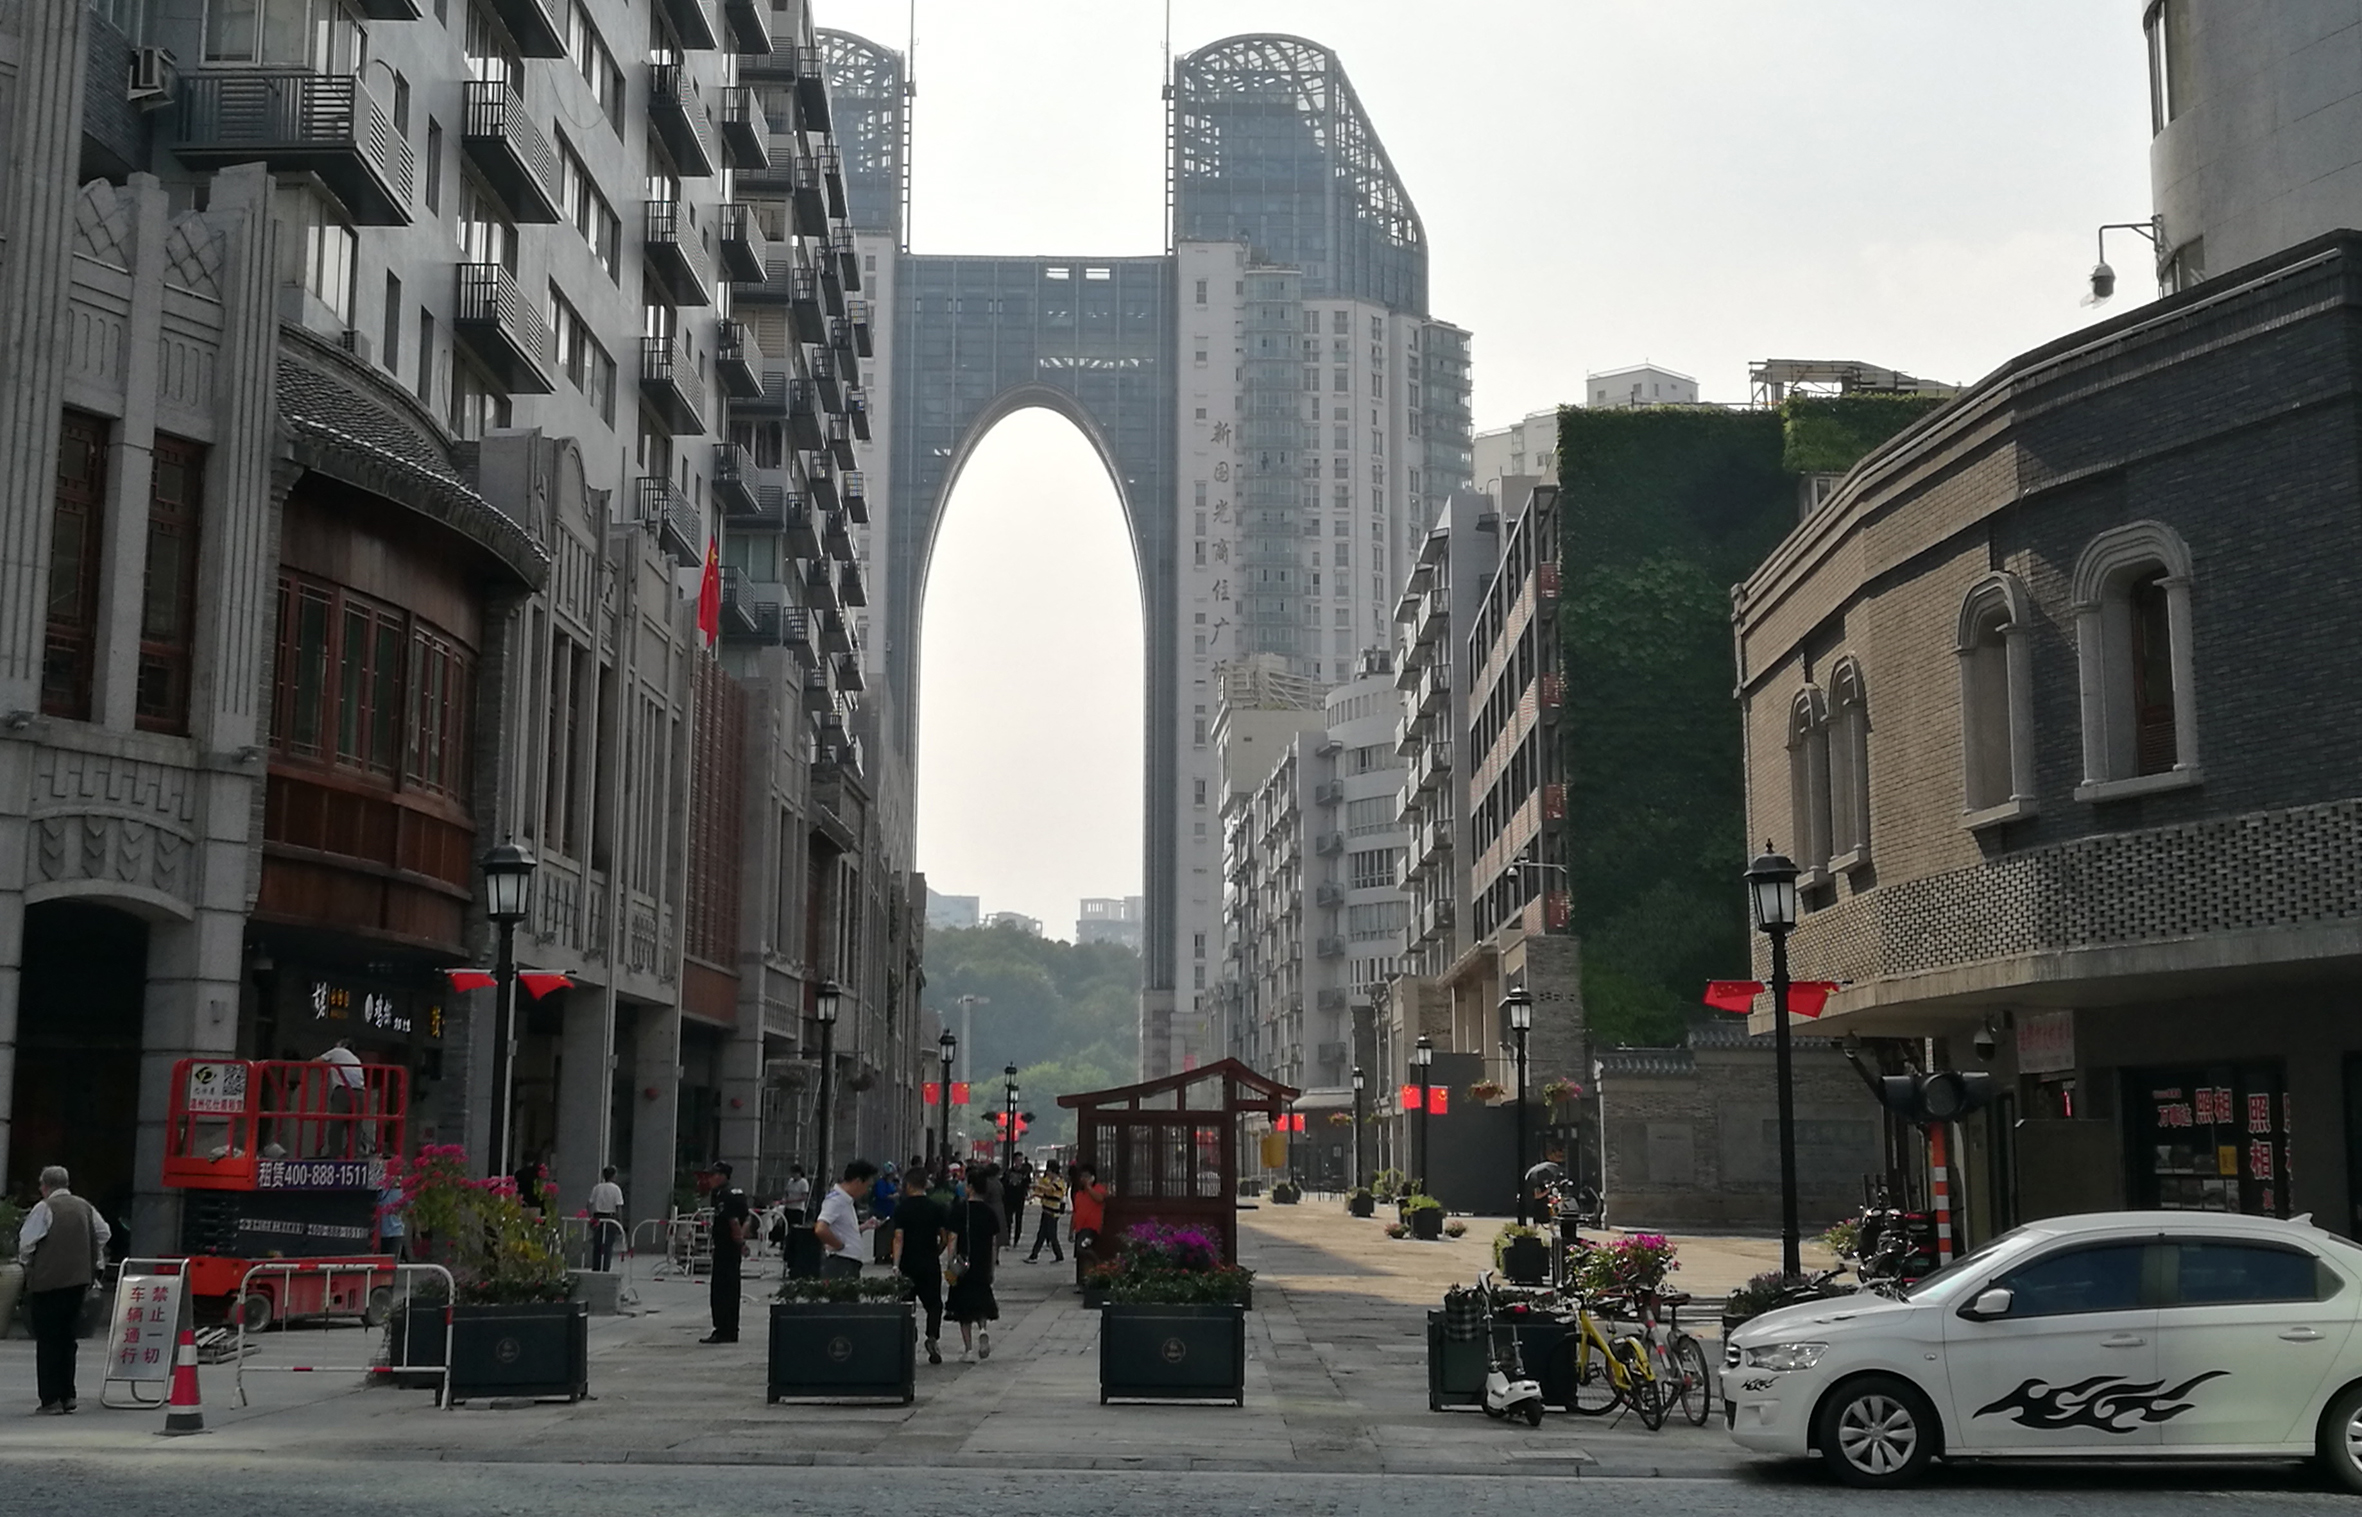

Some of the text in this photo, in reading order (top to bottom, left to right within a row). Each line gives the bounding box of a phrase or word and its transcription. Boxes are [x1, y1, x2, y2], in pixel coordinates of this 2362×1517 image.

[2195, 1087, 2234, 1125] 照相
[2248, 1093, 2274, 1180] 照相
[258, 1161, 367, 1188] 租赁400-888-1511
[120, 1286, 146, 1364] 车辆通行
[142, 1286, 169, 1364] 禁止一切
